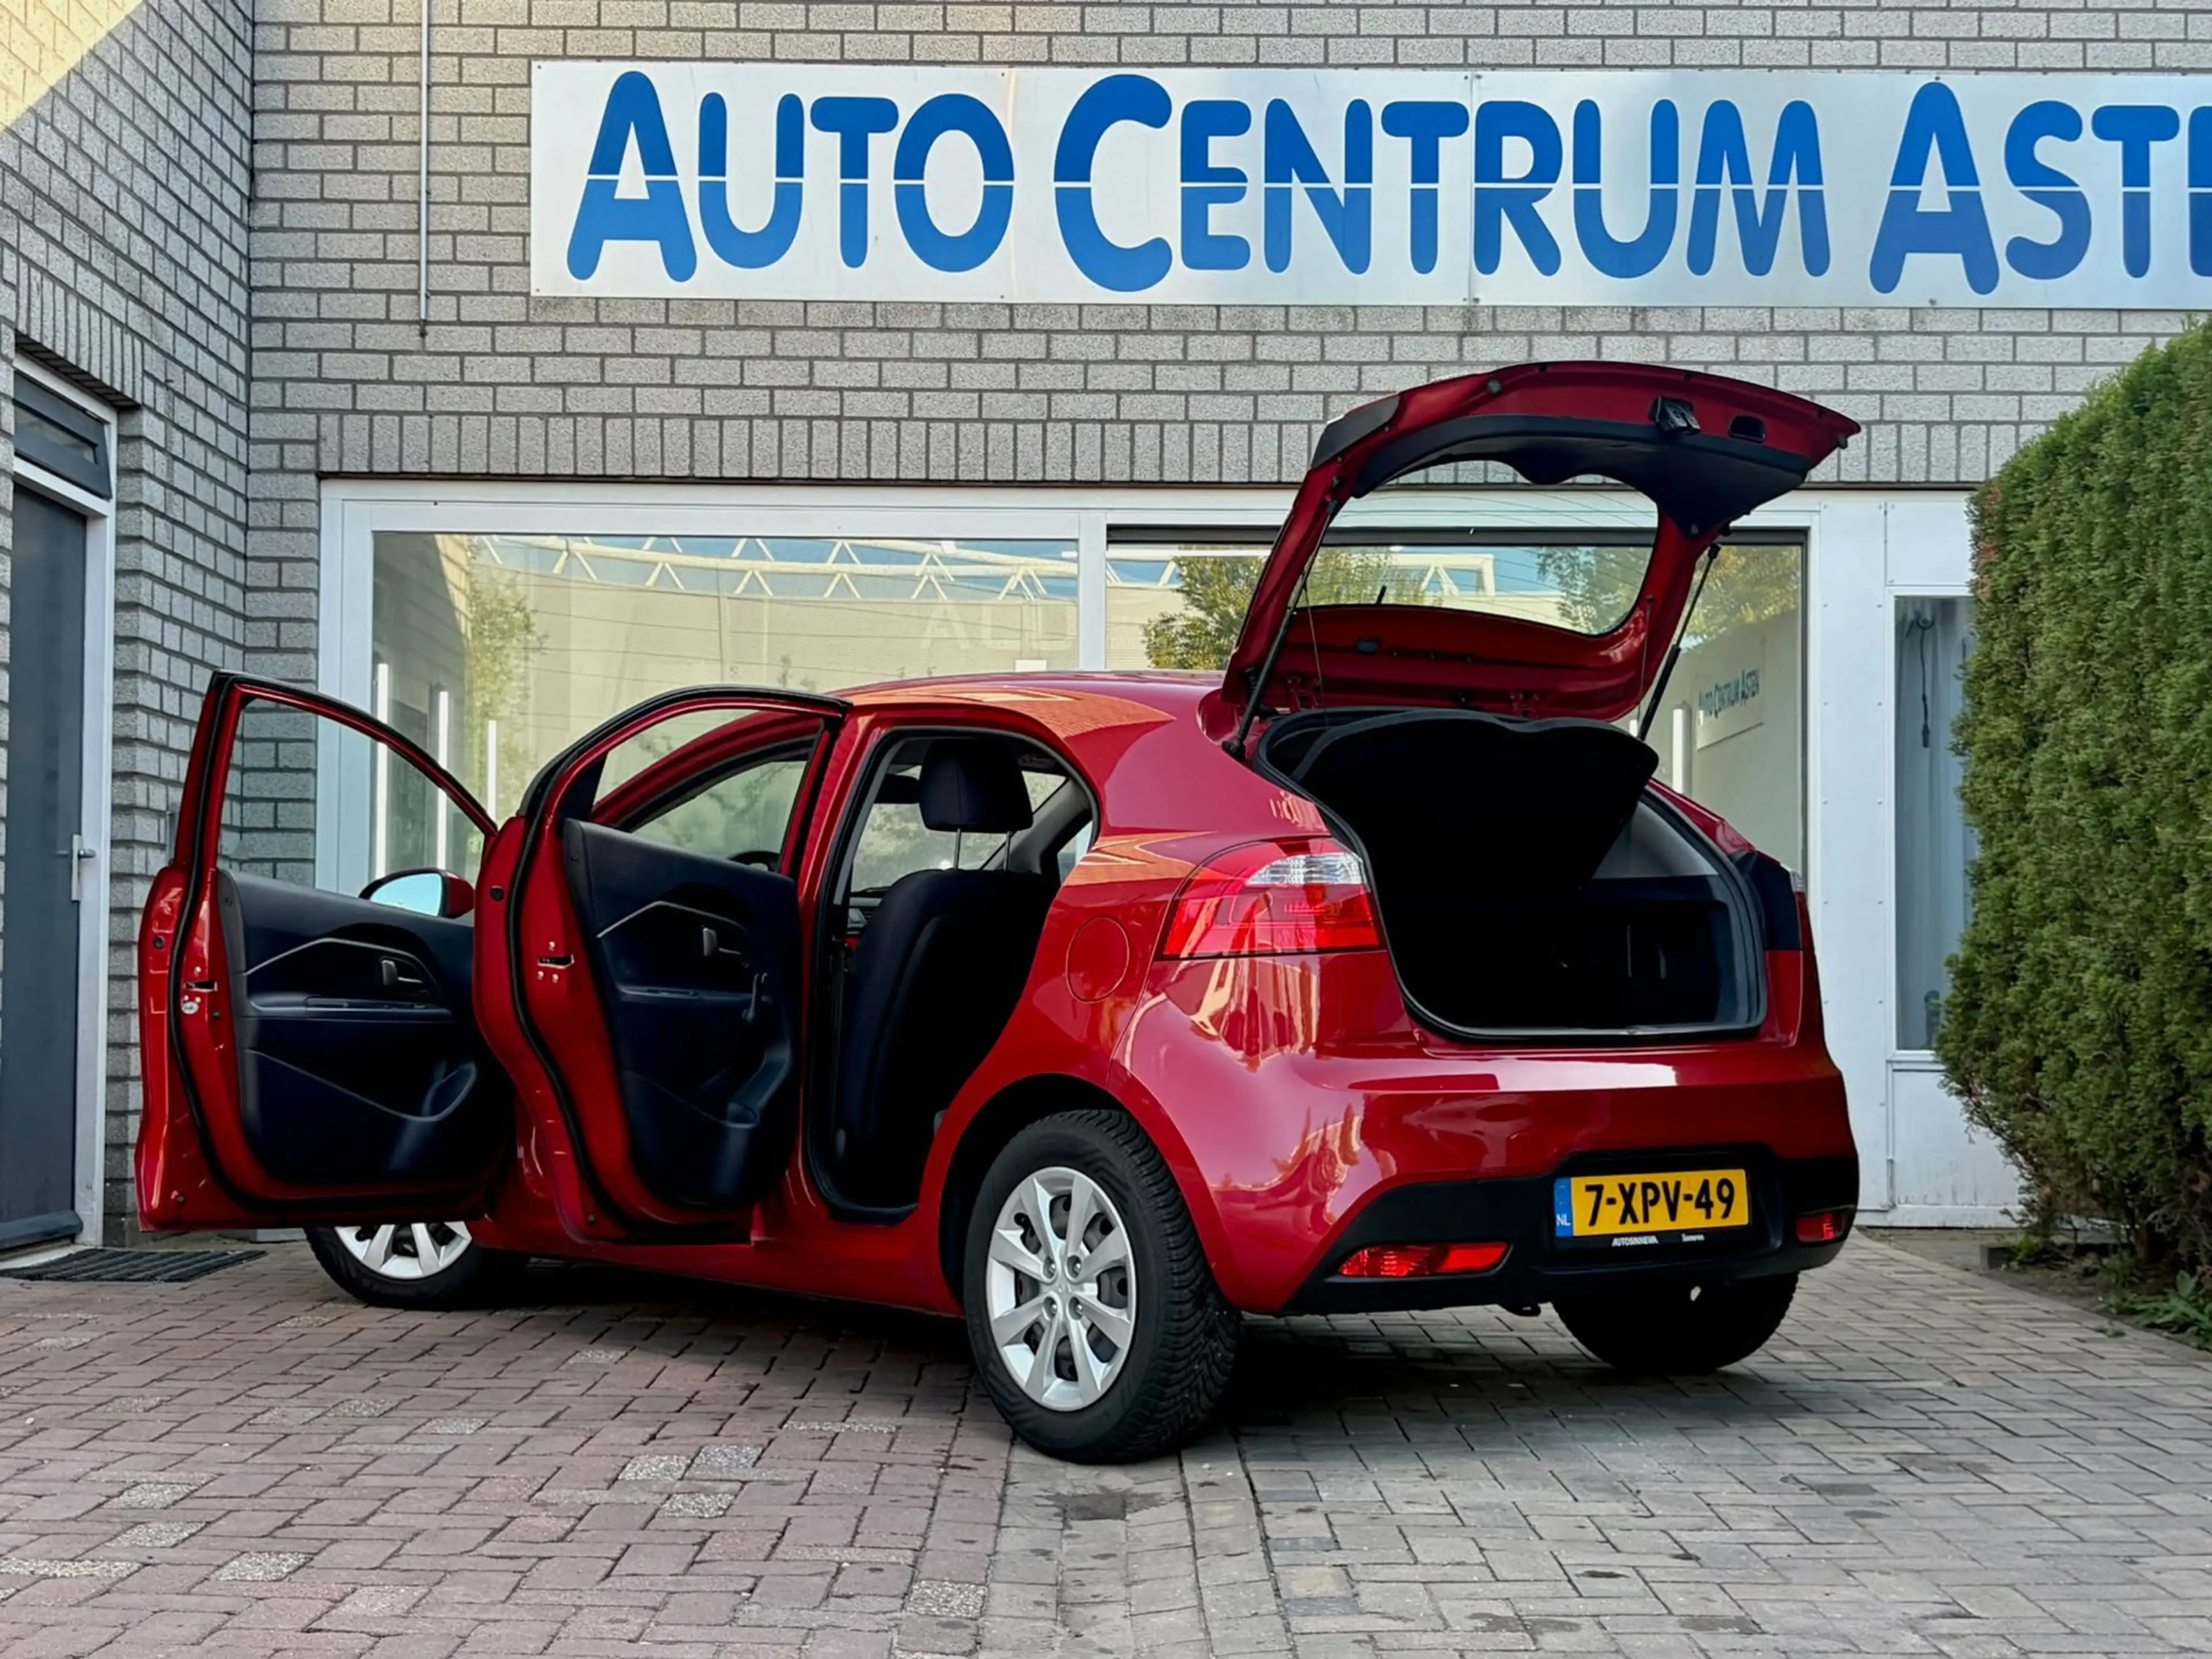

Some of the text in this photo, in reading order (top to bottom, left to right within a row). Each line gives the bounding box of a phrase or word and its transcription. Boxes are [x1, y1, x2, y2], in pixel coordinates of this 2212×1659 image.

[567, 71, 1014, 282] AUTO
[1054, 74, 1831, 293] CENTRUM
[1556, 1213, 1571, 1227] NL
[1584, 1177, 1735, 1227] 7-XPV-49
